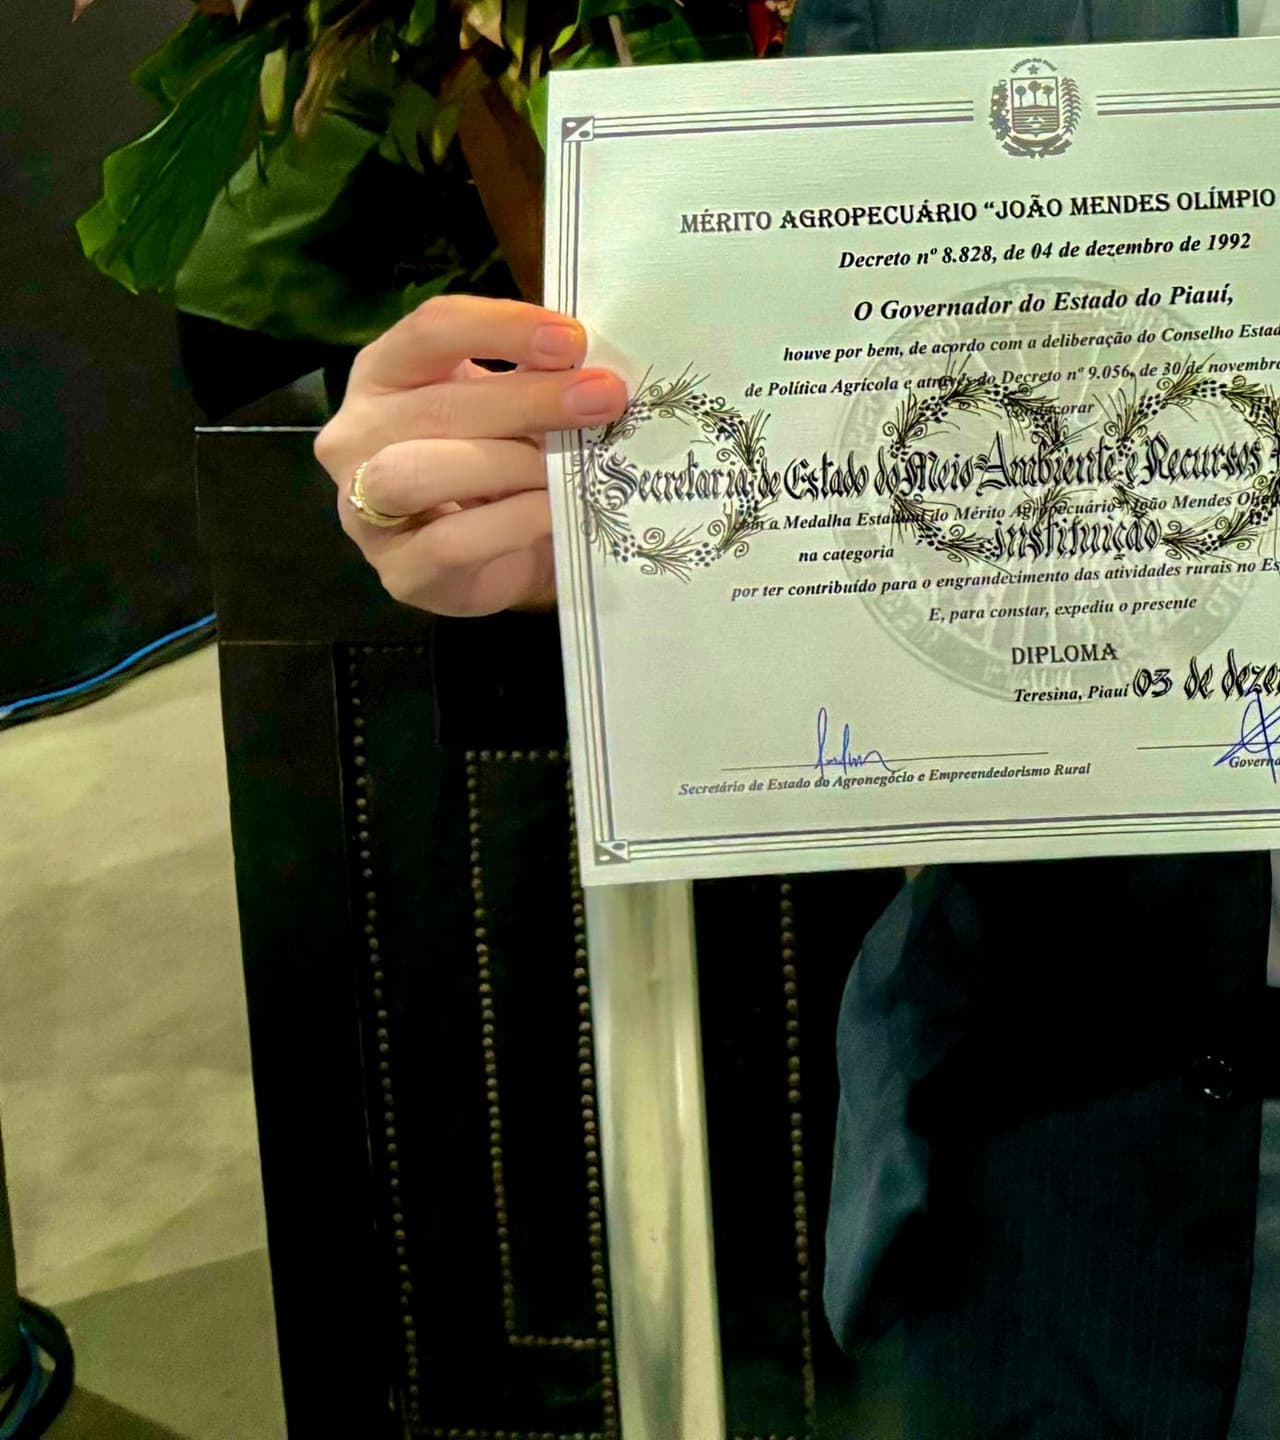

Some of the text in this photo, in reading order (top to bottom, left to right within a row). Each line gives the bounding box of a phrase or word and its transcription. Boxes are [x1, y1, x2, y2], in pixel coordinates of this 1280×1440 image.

[679, 208, 772, 233] MÉRITO
[778, 198, 978, 229] AGROPECUÁRIO
[983, 193, 1063, 220] “JOÃO
[1068, 192, 1171, 216] MENDES
[1175, 185, 1276, 211] OLÍMPIO
[837, 232, 1251, 269] Decreto nº 8.828, de 04 de dezembro de 1992
[853, 282, 1233, 321] O Governador do Estado do Piauí,
[782, 346, 831, 361] houve
[833, 347, 863, 363] por
[866, 342, 904, 358] bem,
[908, 339, 927, 355] de
[930, 337, 985, 354] acordo
[989, 339, 1023, 351] com
[1027, 338, 1037, 349] a
[1041, 327, 1132, 348] deliberação
[1136, 329, 1156, 344] do
[1160, 324, 1234, 342] Conselho
[599, 449, 751, 510] Secretaria
[759, 456, 782, 501] de
[783, 449, 869, 501] Estado
[899, 450, 974, 496] Meio
[974, 431, 1118, 497] Ambiente
[1138, 430, 1263, 487] Recursos
[731, 587, 759, 602] por
[762, 585, 784, 597] ter
[787, 578, 877, 596] contribuído
[879, 579, 917, 595] para
[921, 578, 932, 589] o
[935, 569, 1069, 590] engrandecimento
[1073, 566, 1100, 581] das
[1103, 562, 1181, 580] atividades
[1185, 558, 1234, 575] rurais
[1234, 562, 1256, 573] no
[928, 597, 1197, 624] E, para constar, expediu o presente
[1011, 642, 1119, 665] DIPLOMA
[1013, 686, 1083, 704] Teresina,
[1087, 682, 1130, 699] Piauí
[1131, 667, 1173, 698] 03
[1183, 655, 1215, 700] de
